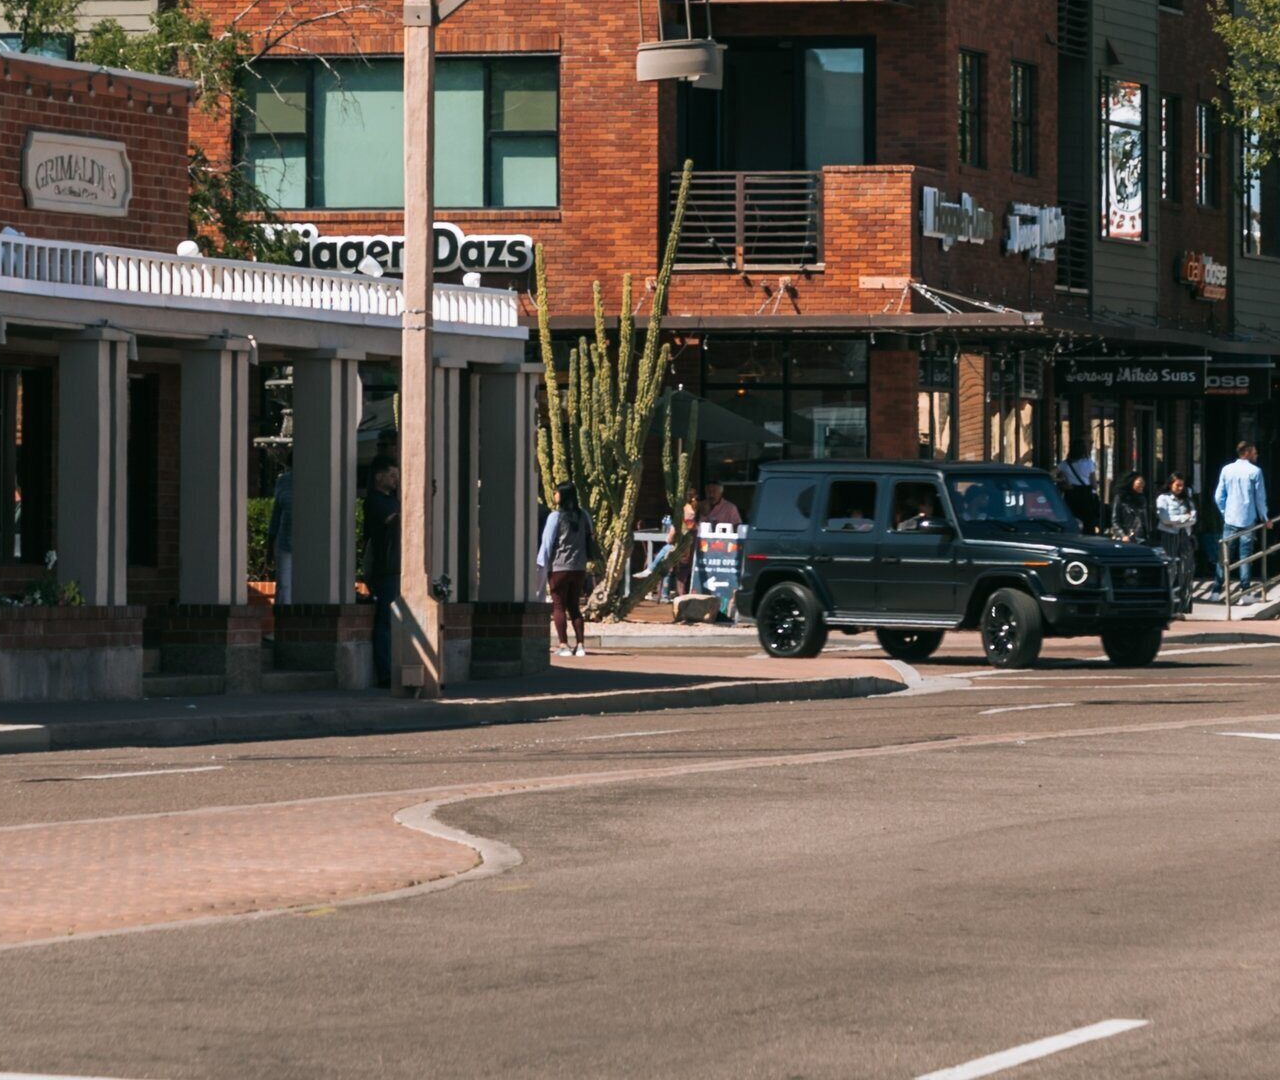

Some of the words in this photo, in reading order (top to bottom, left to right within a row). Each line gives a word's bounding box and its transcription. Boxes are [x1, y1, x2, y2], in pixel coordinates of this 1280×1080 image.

[35, 154, 118, 200] GRIMALDI'S
[1065, 367, 1114, 386] Jersey
[1116, 367, 1159, 383] Mike's
[1161, 369, 1197, 383] SUBS
